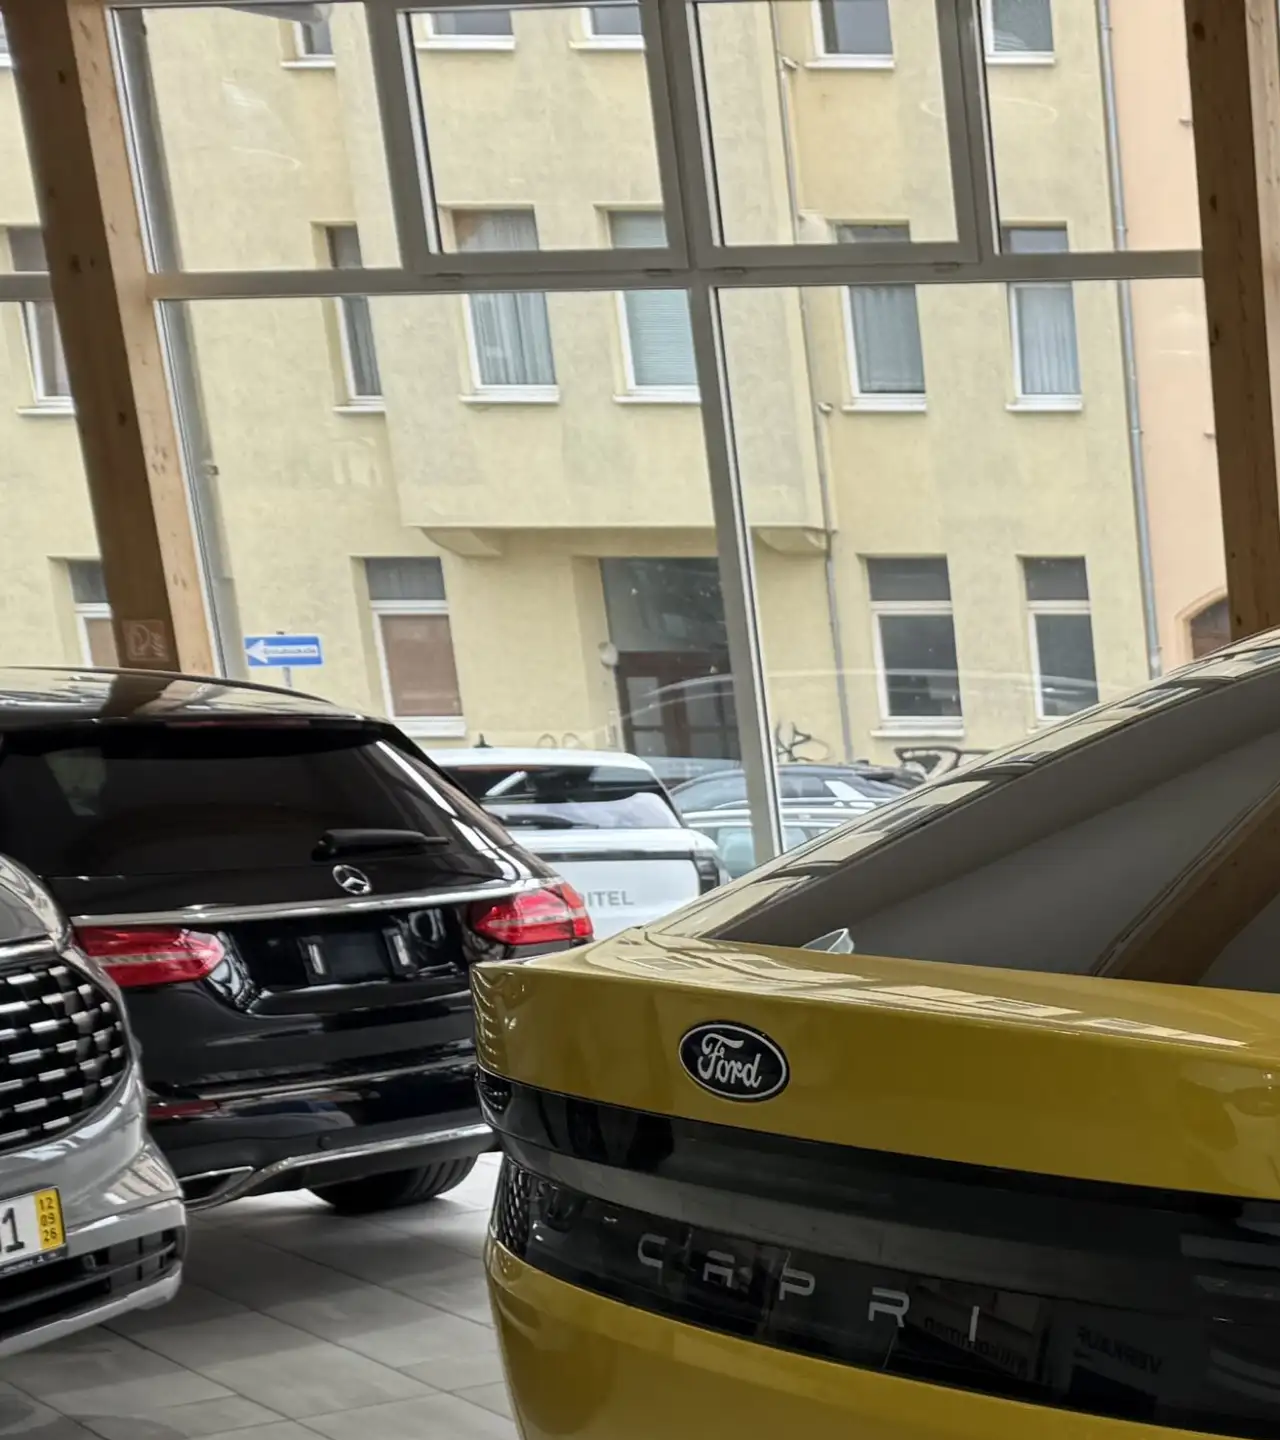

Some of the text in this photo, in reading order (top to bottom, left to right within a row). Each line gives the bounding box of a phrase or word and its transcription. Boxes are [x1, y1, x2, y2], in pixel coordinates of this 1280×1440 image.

[585, 890, 635, 908] ITEL
[697, 1032, 762, 1089] Ford
[637, 1232, 980, 1342] CAPRI
